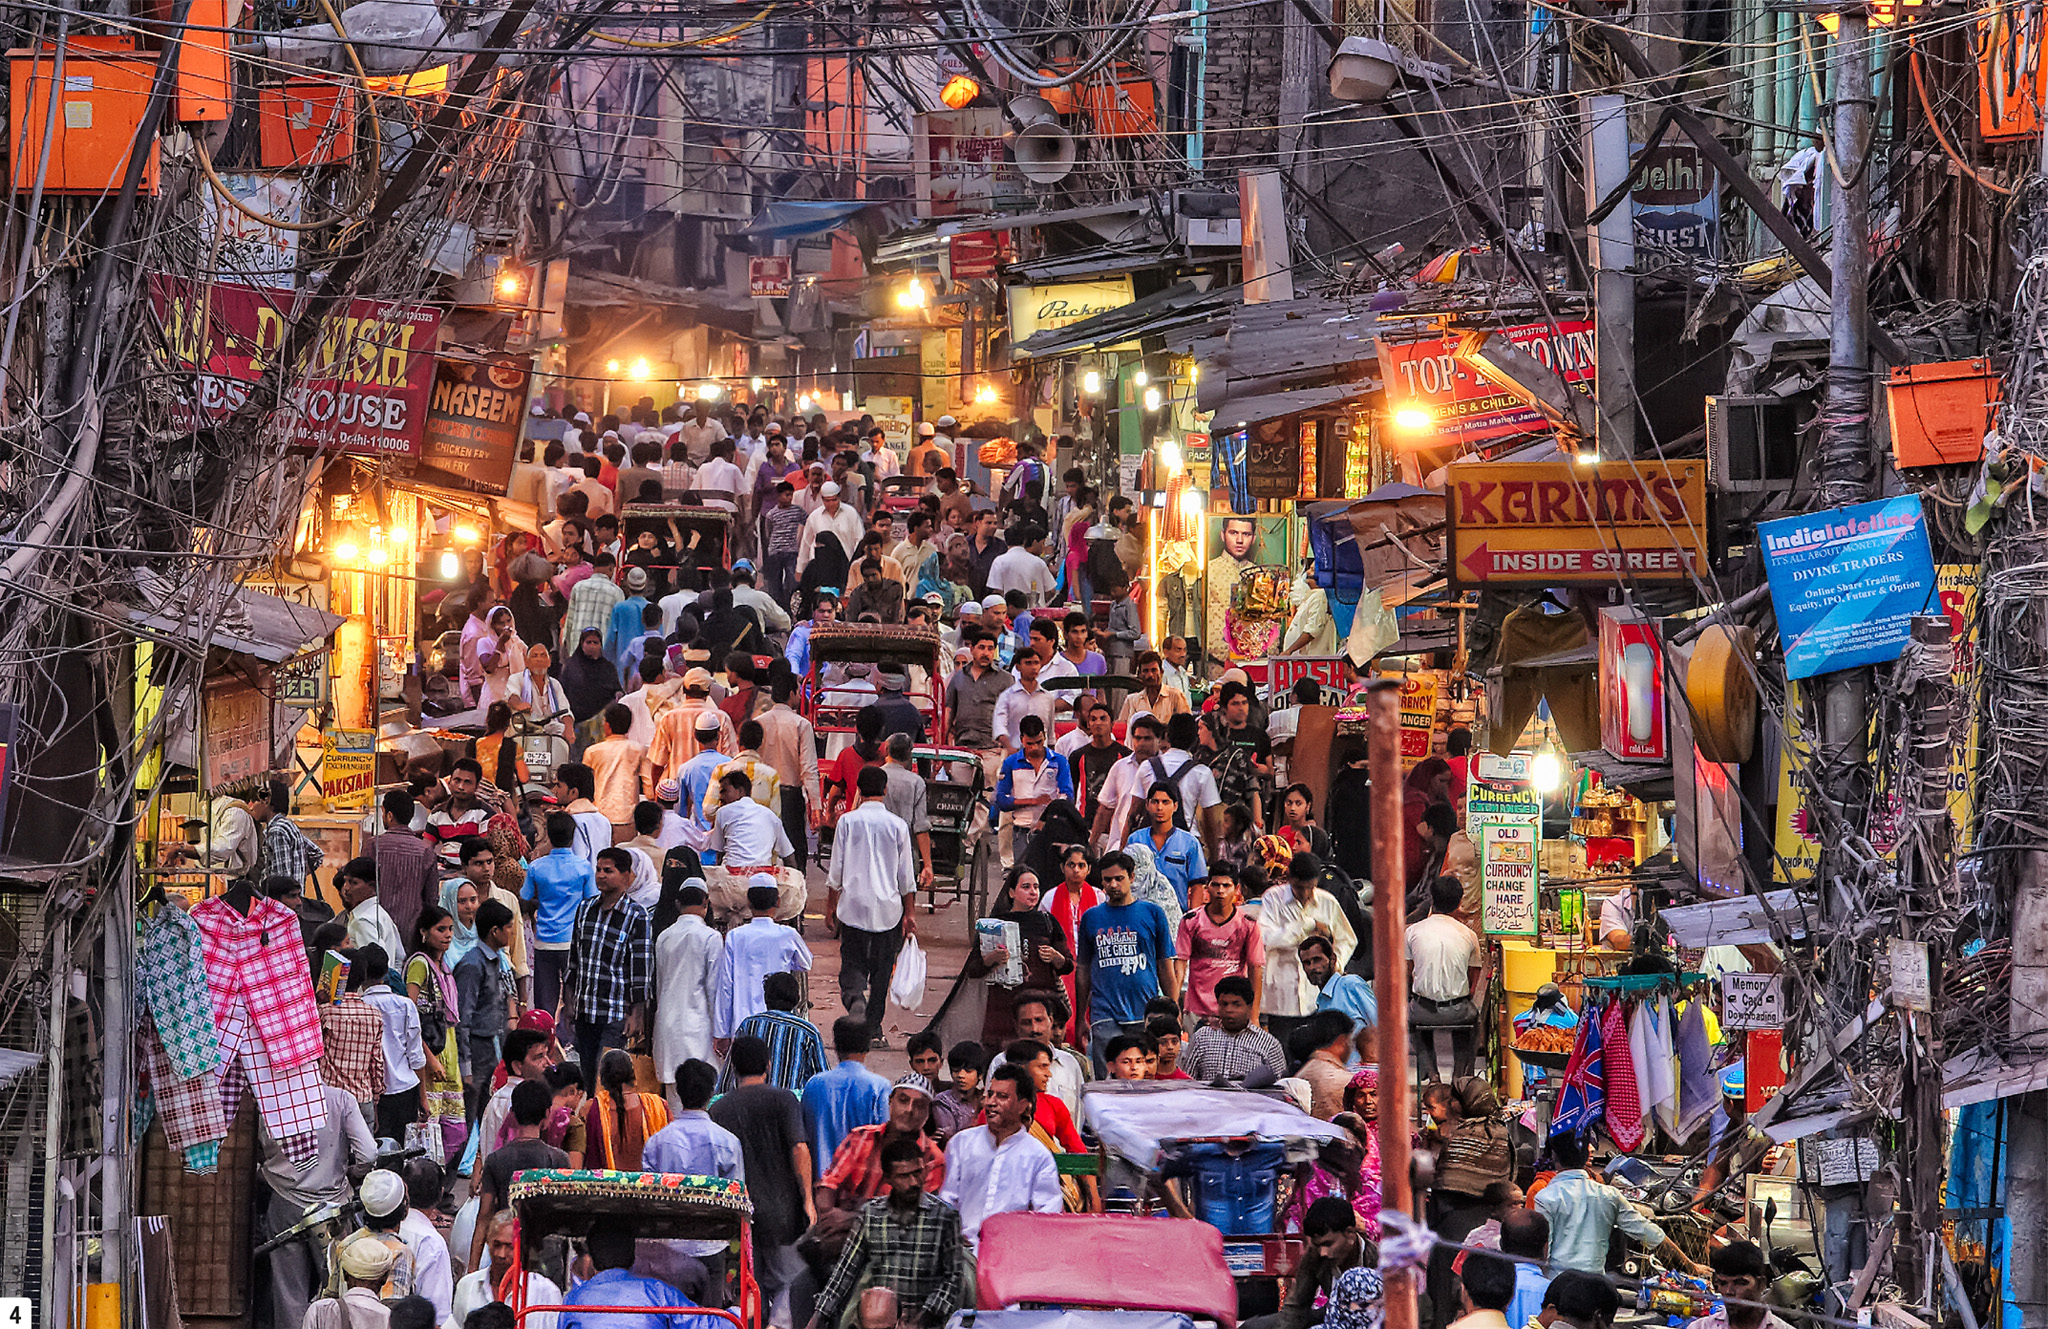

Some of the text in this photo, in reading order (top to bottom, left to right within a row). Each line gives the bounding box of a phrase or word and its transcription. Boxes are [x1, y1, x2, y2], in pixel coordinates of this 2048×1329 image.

[433, 380, 522, 425] NASEEM
[428, 418, 471, 439] CHICKEN
[435, 441, 471, 458] CHICKEN
[1458, 471, 1688, 525] KARIM'S
[1493, 551, 1696, 571] INSIDE STREET
[1793, 551, 1904, 582] DIVINE TRADERS
[1805, 574, 1901, 599] Online Share Trading
[1847, 589, 1877, 602] Future
[1879, 586, 1887, 595] &
[1889, 580, 1921, 594] Option
[323, 770, 374, 799] PAKISTANI
[1470, 784, 1538, 805] CURRENCY
[1491, 782, 1513, 791] OLD
[1498, 828, 1519, 838] OLD
[1485, 863, 1534, 878] CURRUNCY
[1486, 880, 1525, 891] CHANGE
[1496, 894, 1524, 905] HARE
[1098, 944, 1137, 958] THE GREAT
[1728, 1009, 1777, 1021] Downloading
